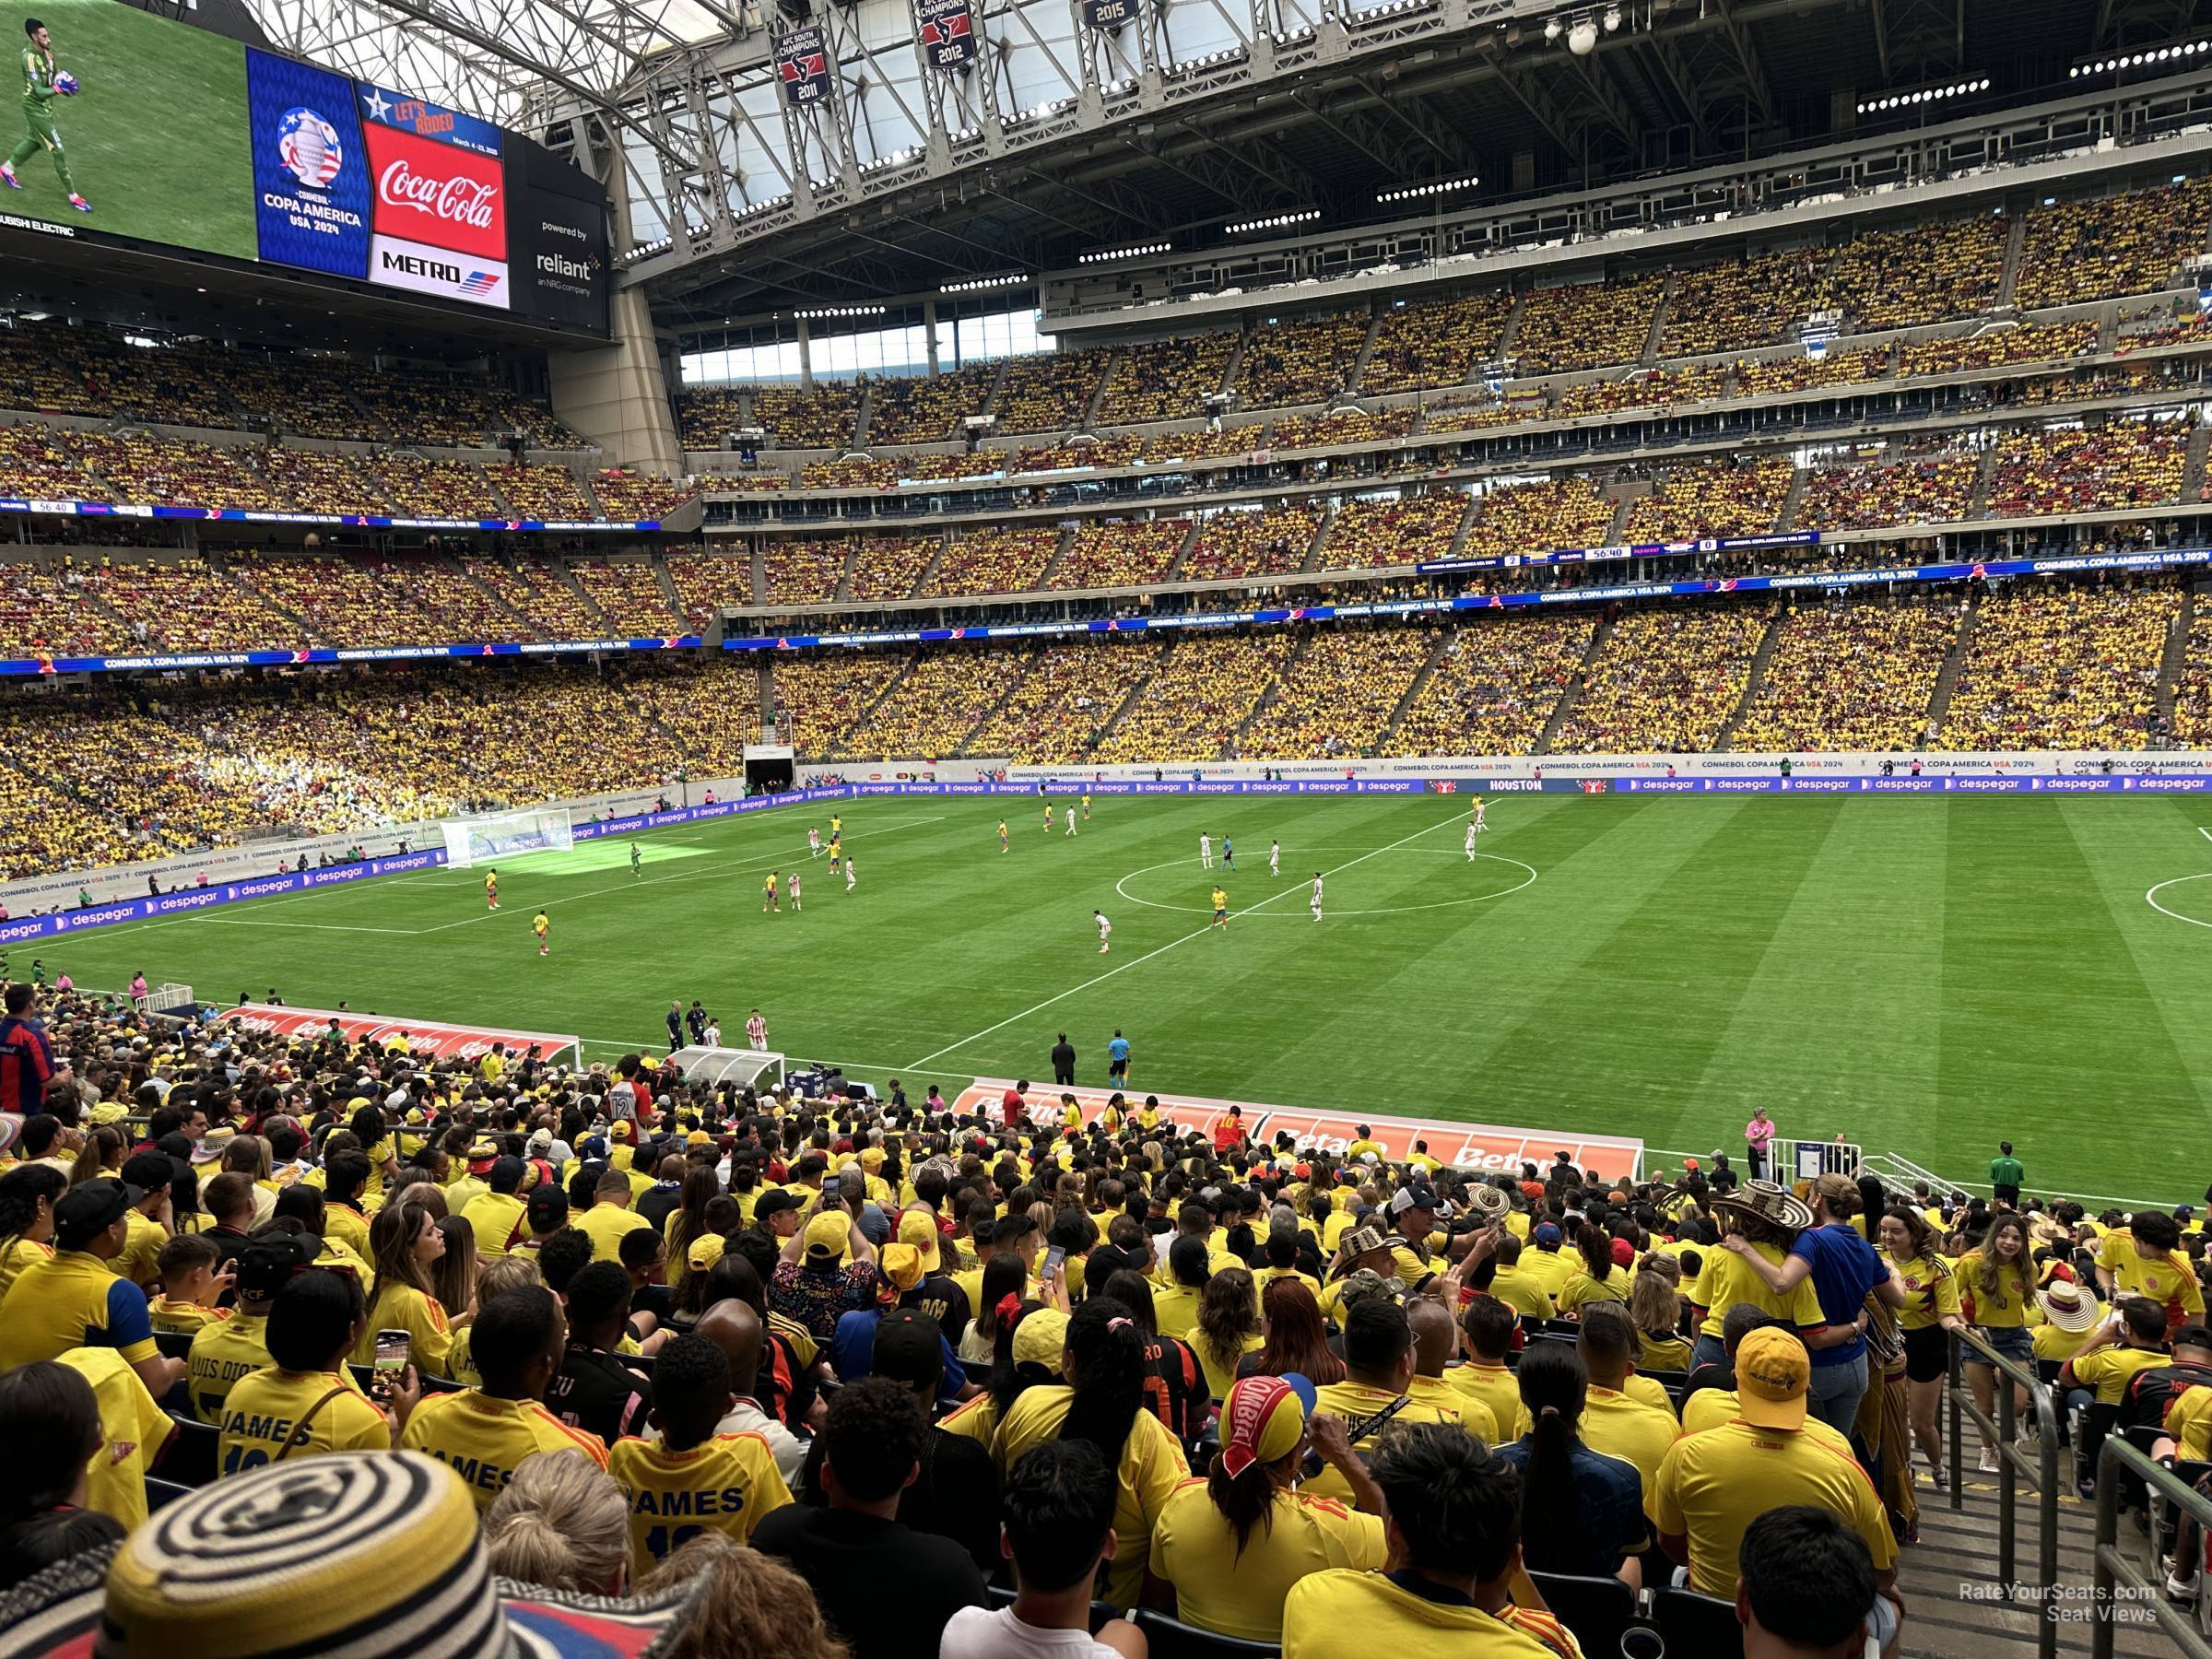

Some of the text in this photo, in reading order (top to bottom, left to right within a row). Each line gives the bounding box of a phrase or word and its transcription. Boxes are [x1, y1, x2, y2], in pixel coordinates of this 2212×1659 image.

[922, 0, 965, 18] CHAMPIONS
[1096, 2, 1125, 22] 2015
[782, 31, 814, 46] AFC SOUTH
[780, 39, 819, 56] CHAMPIONS
[938, 45, 964, 65] 2012
[798, 83, 818, 100] 2011
[395, 100, 426, 123] LET'S
[416, 112, 454, 135] RODEO
[453, 136, 471, 148] March
[380, 160, 499, 229] Coca-Cola
[265, 194, 361, 228] COPA AMERICA
[32, 218, 74, 237] ELECTRIC
[290, 215, 339, 236] USA 2024
[542, 221, 587, 242] powered by
[383, 252, 461, 284] METRO
[536, 253, 591, 281] reliant
[537, 278, 591, 298] an NRG company
[1594, 548, 1623, 558] 56:40
[1706, 541, 1712, 549] 0
[1511, 557, 1516, 565] 2
[2034, 552, 2209, 571] CONMEBOL COPA AMERICA USA 2024
[1770, 570, 1919, 587] CONMEBOL COPA AMERICA USA 2024
[1541, 586, 1672, 602] CONMEBOL COPA AMERICA USA 2024
[814, 787, 846, 798] despegar
[1096, 783, 1130, 793] despegar
[1146, 782, 1182, 792] despegar
[1197, 782, 1234, 792] despegar
[1253, 782, 1289, 791] despegar
[1310, 782, 1348, 791] despegar
[1369, 782, 1410, 791] despegar
[1490, 780, 1543, 791] HOUSTON
[1643, 780, 1694, 790] despegar
[1718, 780, 1771, 790] despegar
[1795, 780, 1850, 790] despegar
[1876, 780, 1932, 790] despegar
[1959, 779, 2019, 790] despegar
[2048, 779, 2111, 790] despegar
[2139, 779, 2206, 790] despegar
[741, 799, 768, 811] despegar
[609, 819, 643, 833] despegar
[135, 866, 170, 877] CONMEBOL
[170, 864, 188, 872] COPA
[187, 860, 214, 869] AMERICA
[383, 855, 428, 871] despegar
[315, 866, 364, 883] despegar
[0, 887, 39, 897] CONMEBOL
[40, 884, 60, 893] COPA
[61, 878, 90, 888] AMERICA
[90, 876, 104, 885] USA
[241, 877, 294, 895] despegar
[161, 891, 218, 911] despegar
[73, 905, 135, 925] despegar
[611, 1097, 631, 1120] 12
[1220, 1117, 1235, 1130] 10
[192, 1357, 218, 1379] LUIS
[221, 1410, 315, 1447] JAMES
[631, 1487, 746, 1518] AMES
